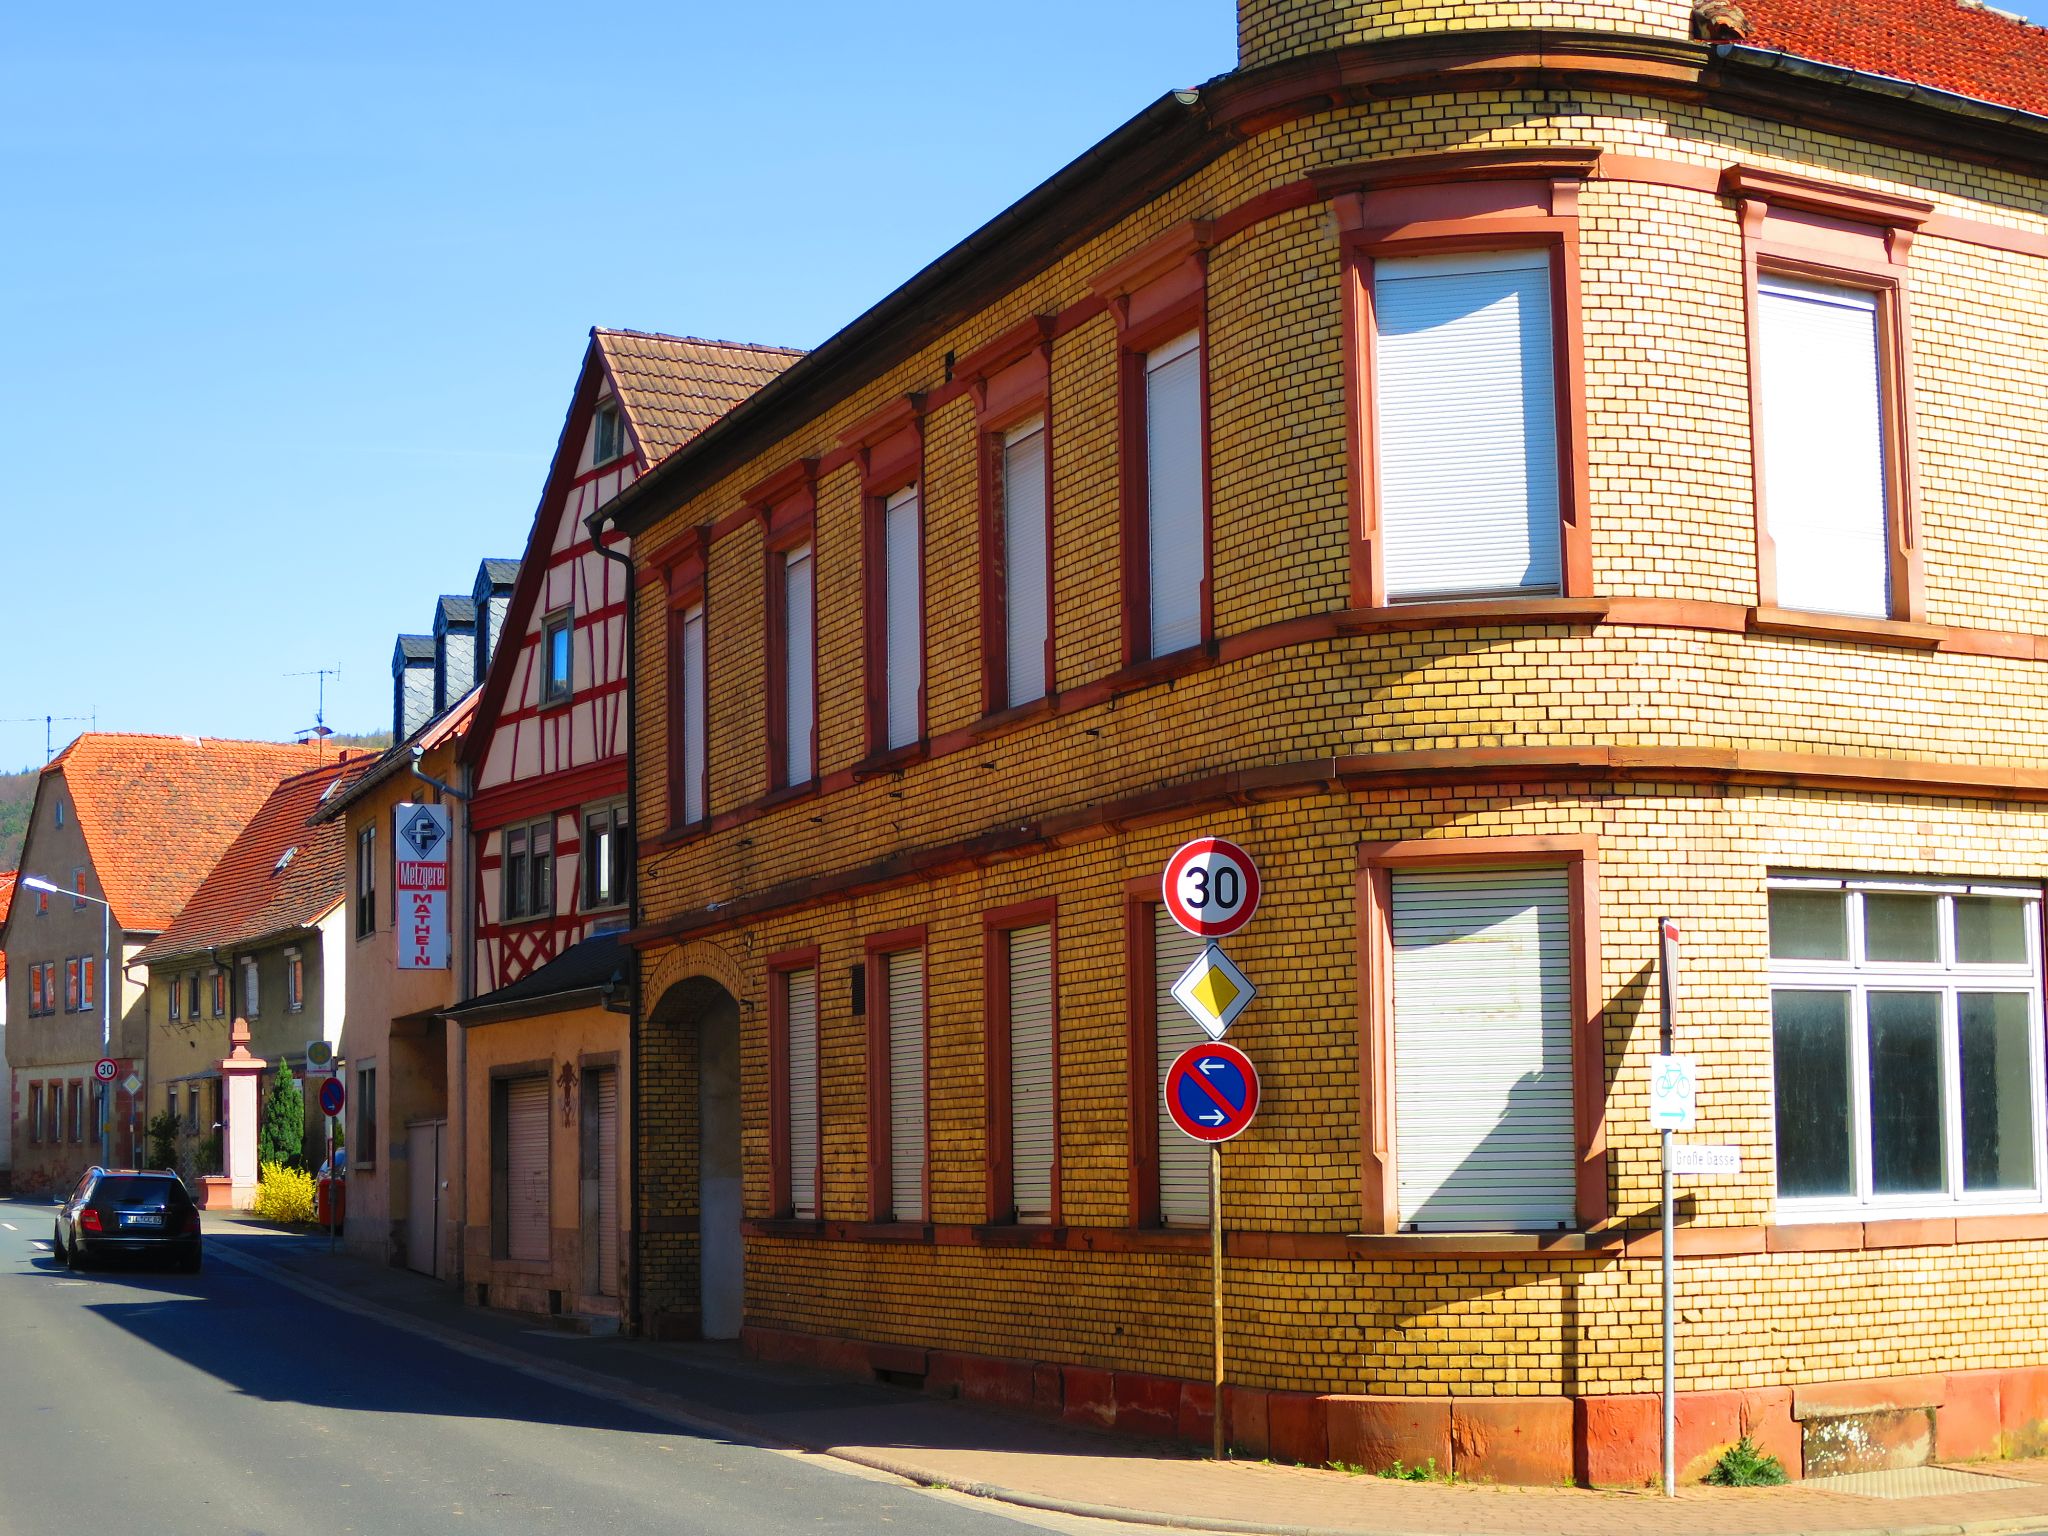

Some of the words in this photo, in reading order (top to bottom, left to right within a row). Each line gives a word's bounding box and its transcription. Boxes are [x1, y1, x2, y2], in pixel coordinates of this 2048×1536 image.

[401, 863, 444, 889] Metzgerei
[1186, 867, 1238, 909] 30
[413, 894, 431, 966] MATHEIN
[100, 1065, 113, 1075] 30
[1676, 1150, 1704, 1166] Große
[1706, 1150, 1735, 1166] Gasse
